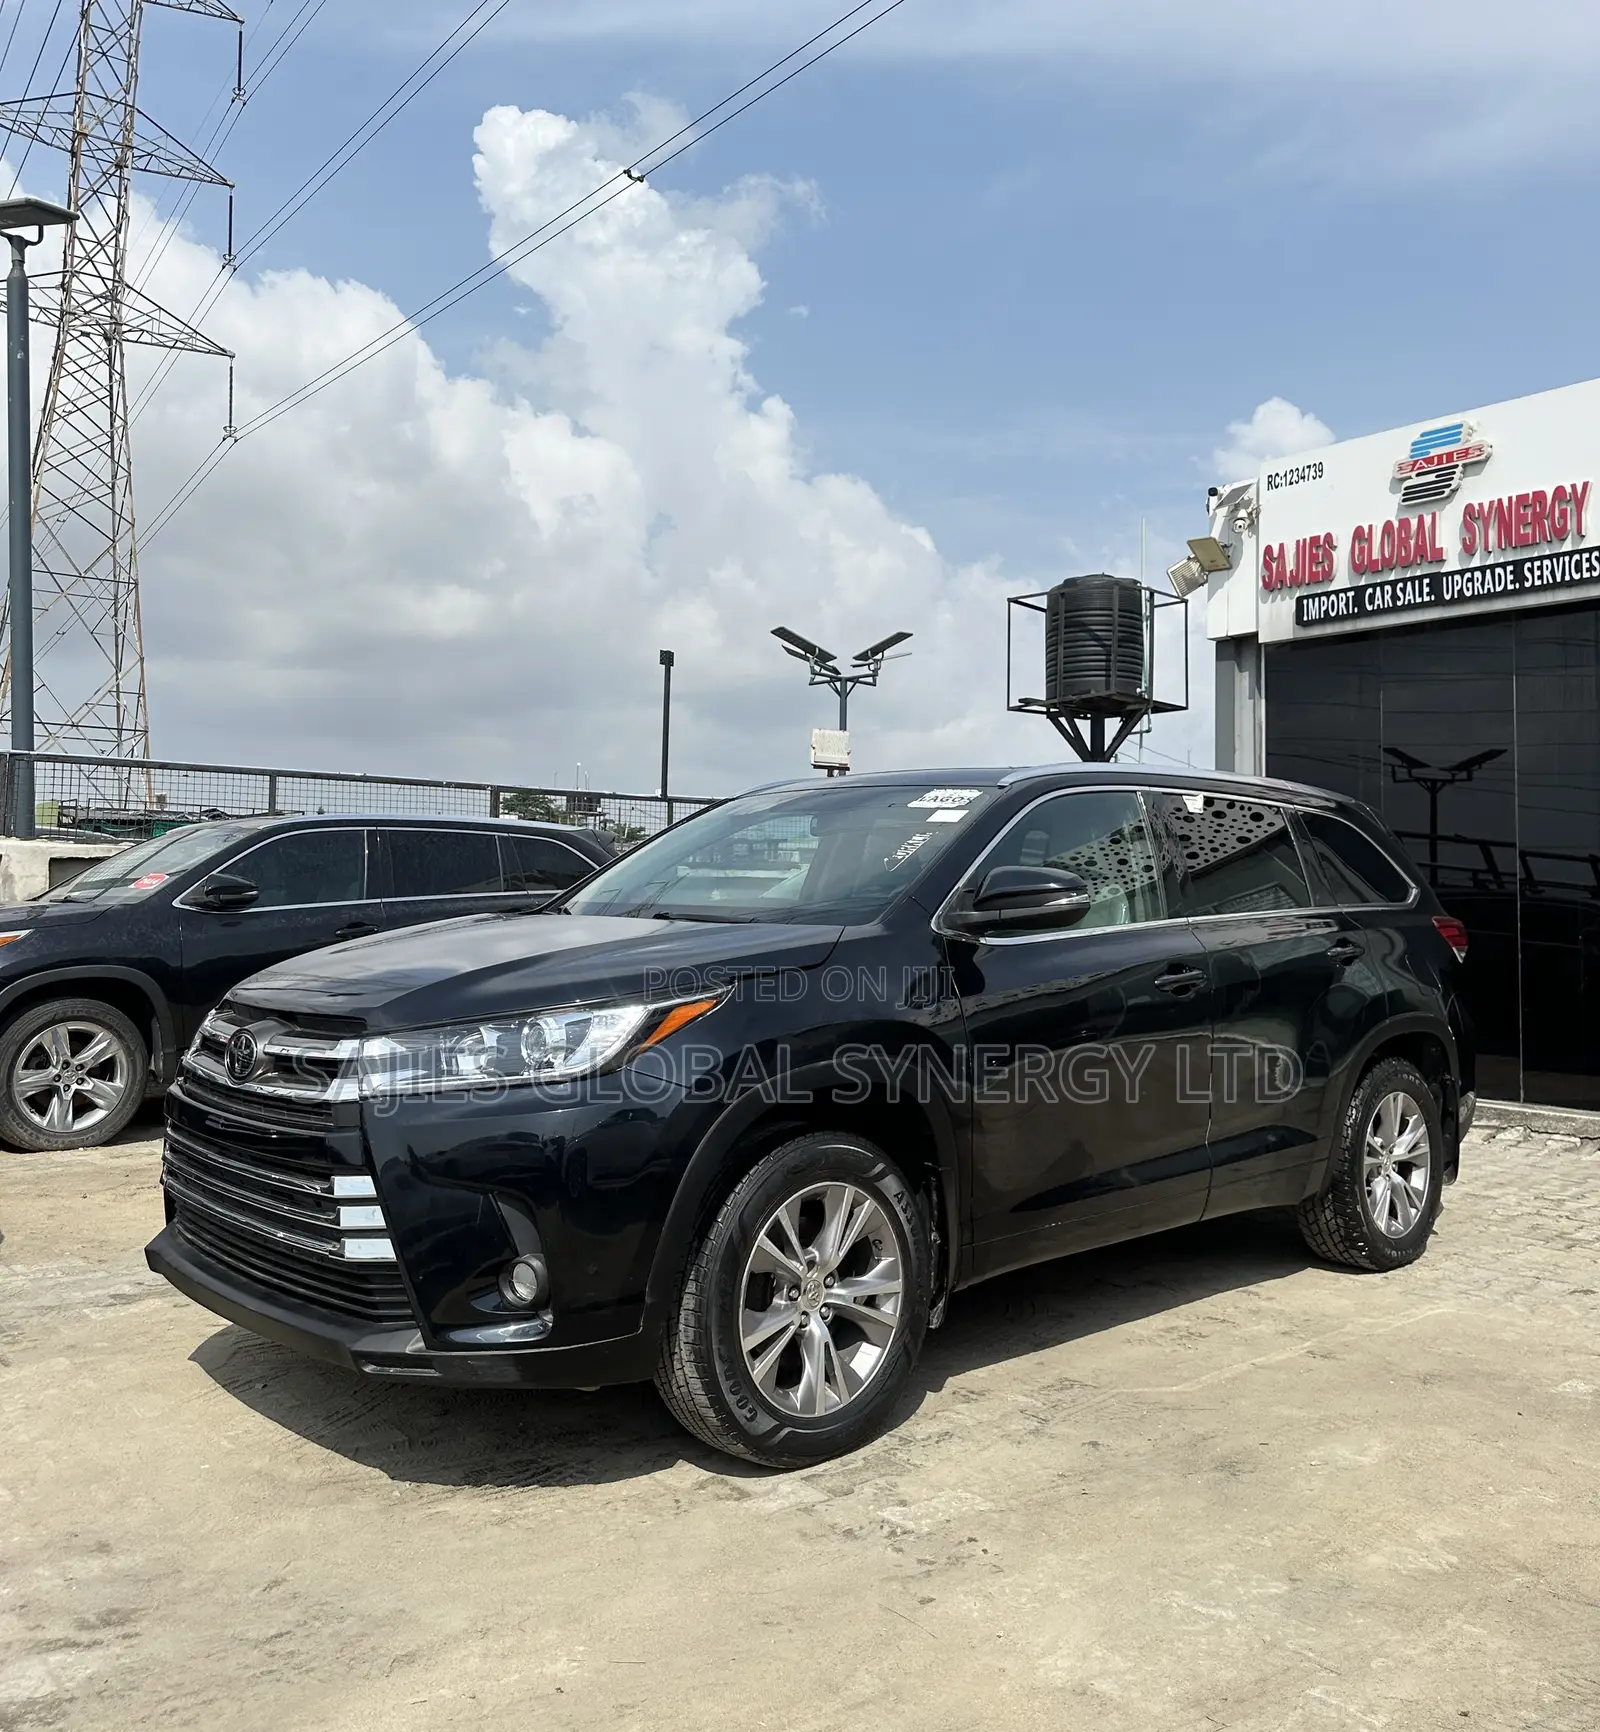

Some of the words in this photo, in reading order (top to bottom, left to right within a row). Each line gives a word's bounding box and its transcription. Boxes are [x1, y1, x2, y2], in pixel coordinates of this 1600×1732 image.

[1266, 461, 1324, 491] RC:1234739
[1396, 443, 1486, 475] SAJIES
[1261, 532, 1337, 592] SAJIES
[1350, 511, 1446, 575] GLOBAL
[1462, 481, 1592, 556] SYNERGY
[1302, 590, 1358, 621] IMPORT.
[1365, 585, 1393, 612] CAR
[1396, 578, 1435, 607] SALE.
[1442, 565, 1520, 601] UPGRADE.
[1523, 551, 1600, 588] SERVICES
